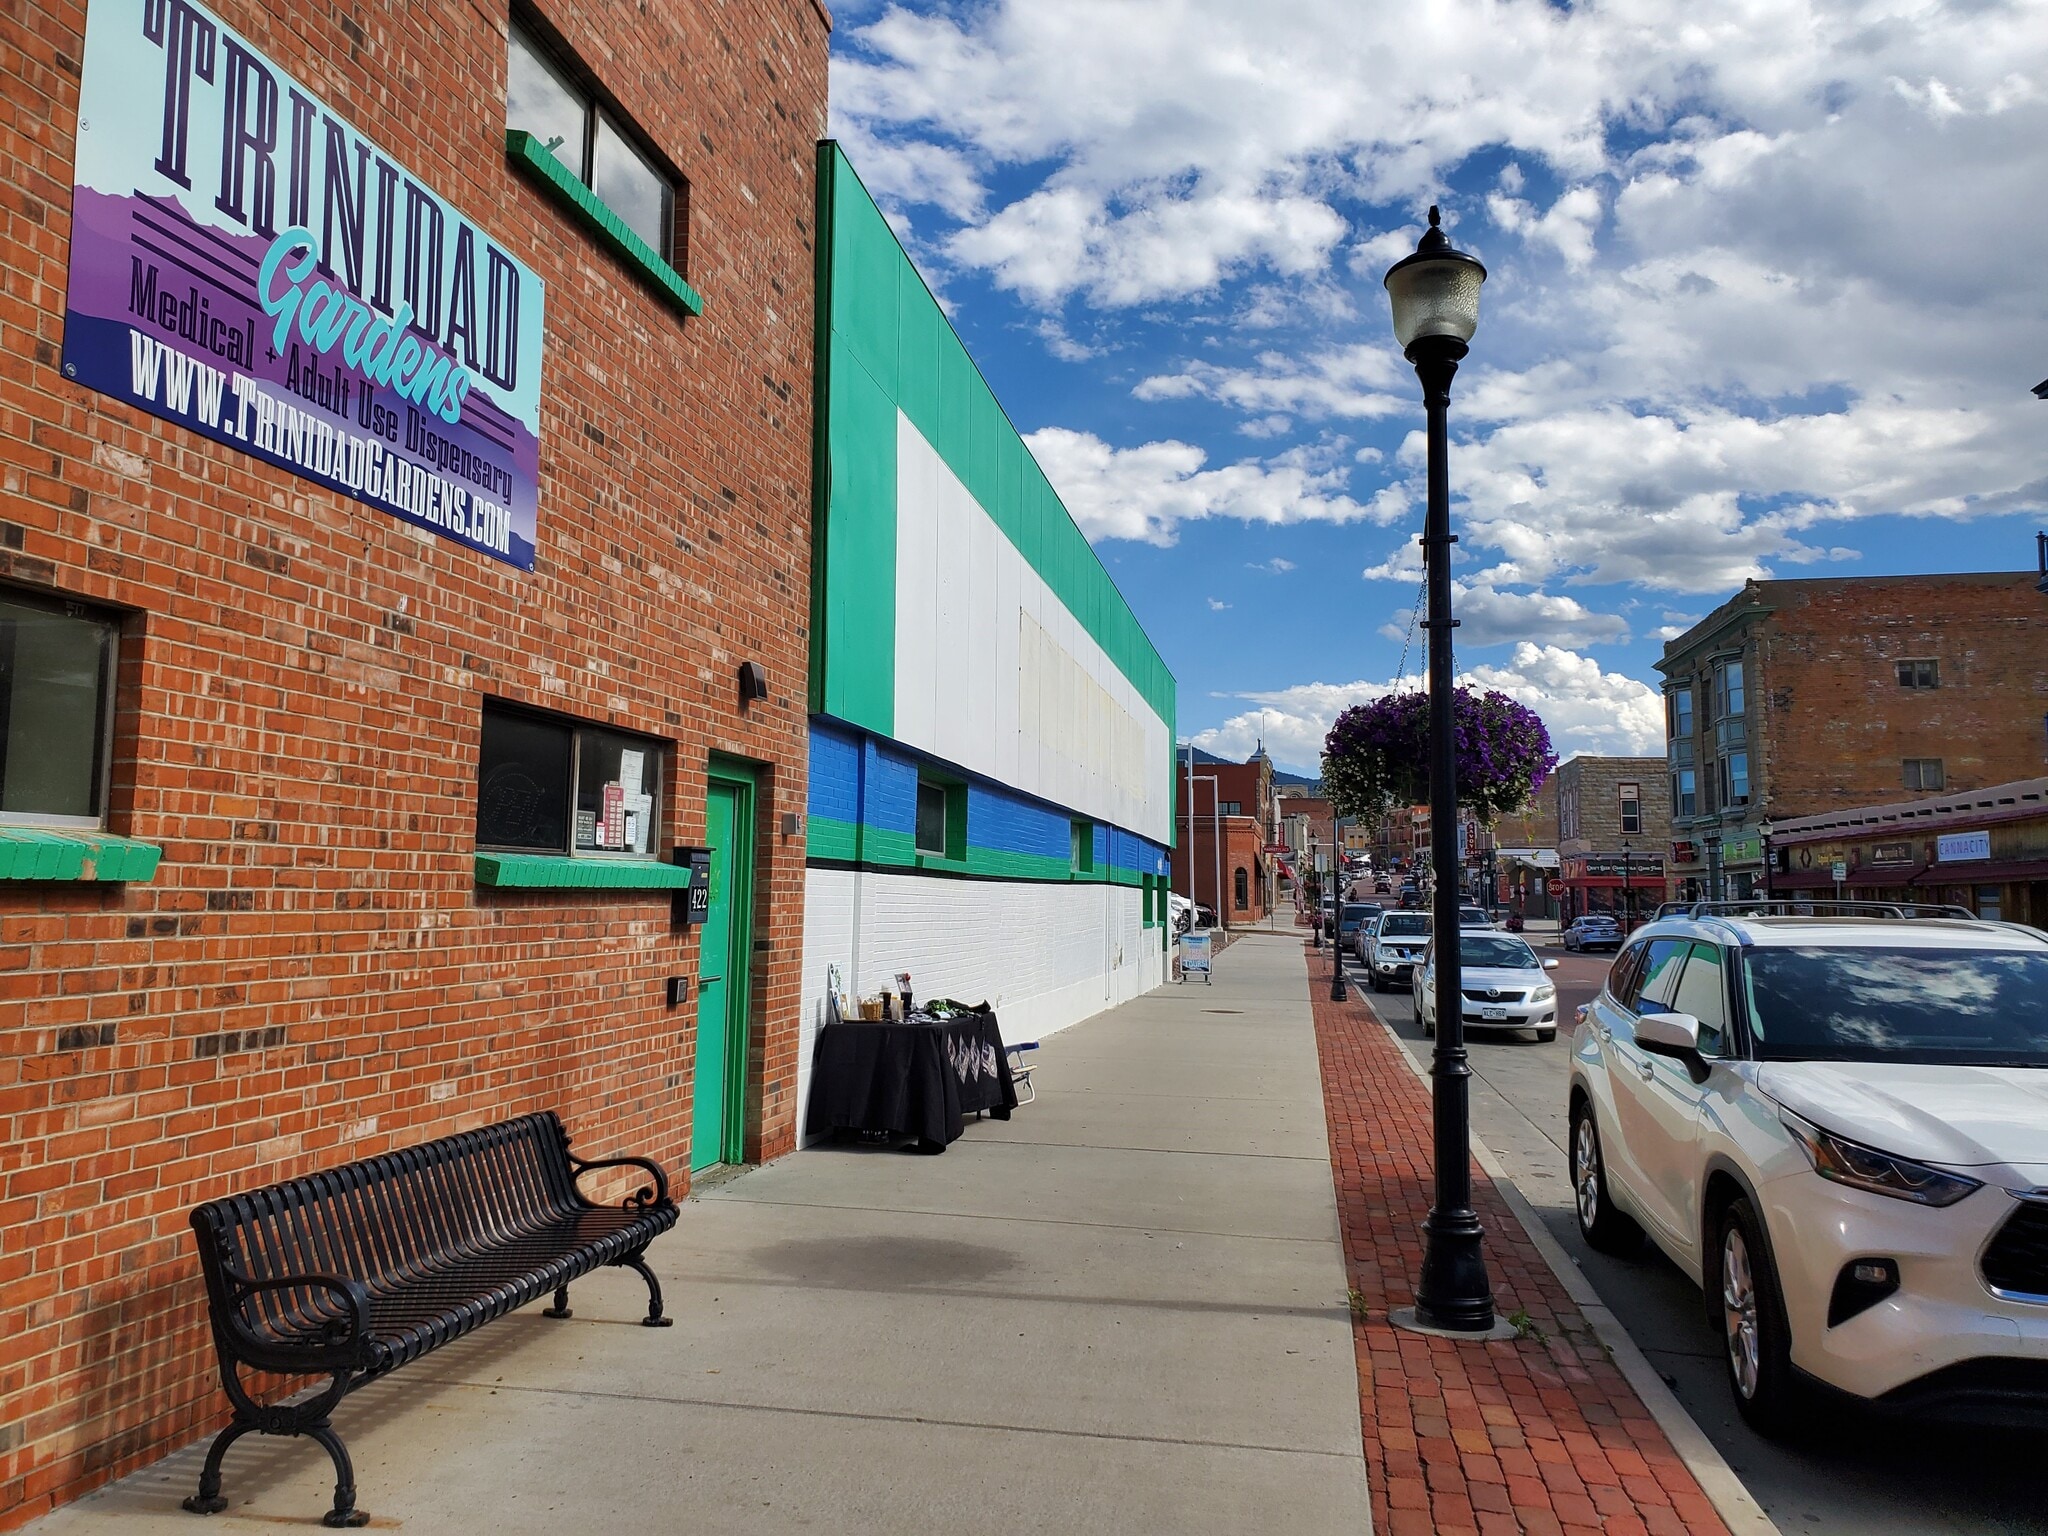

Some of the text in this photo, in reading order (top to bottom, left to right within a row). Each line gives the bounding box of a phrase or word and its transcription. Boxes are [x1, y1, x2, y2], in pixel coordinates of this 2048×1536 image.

[143, 0, 521, 393] TRINIDAD
[127, 255, 255, 371] Medical
[284, 343, 351, 408] Adult
[356, 383, 399, 440] Use
[404, 404, 514, 506] Dispensary
[257, 226, 471, 425] Gardens
[130, 328, 511, 556] WWW.TRINIDADGARDENS.COM
[691, 888, 708, 910] 422
[1548, 884, 1564, 892] STOP
[1939, 839, 1989, 856] CANNACITY
